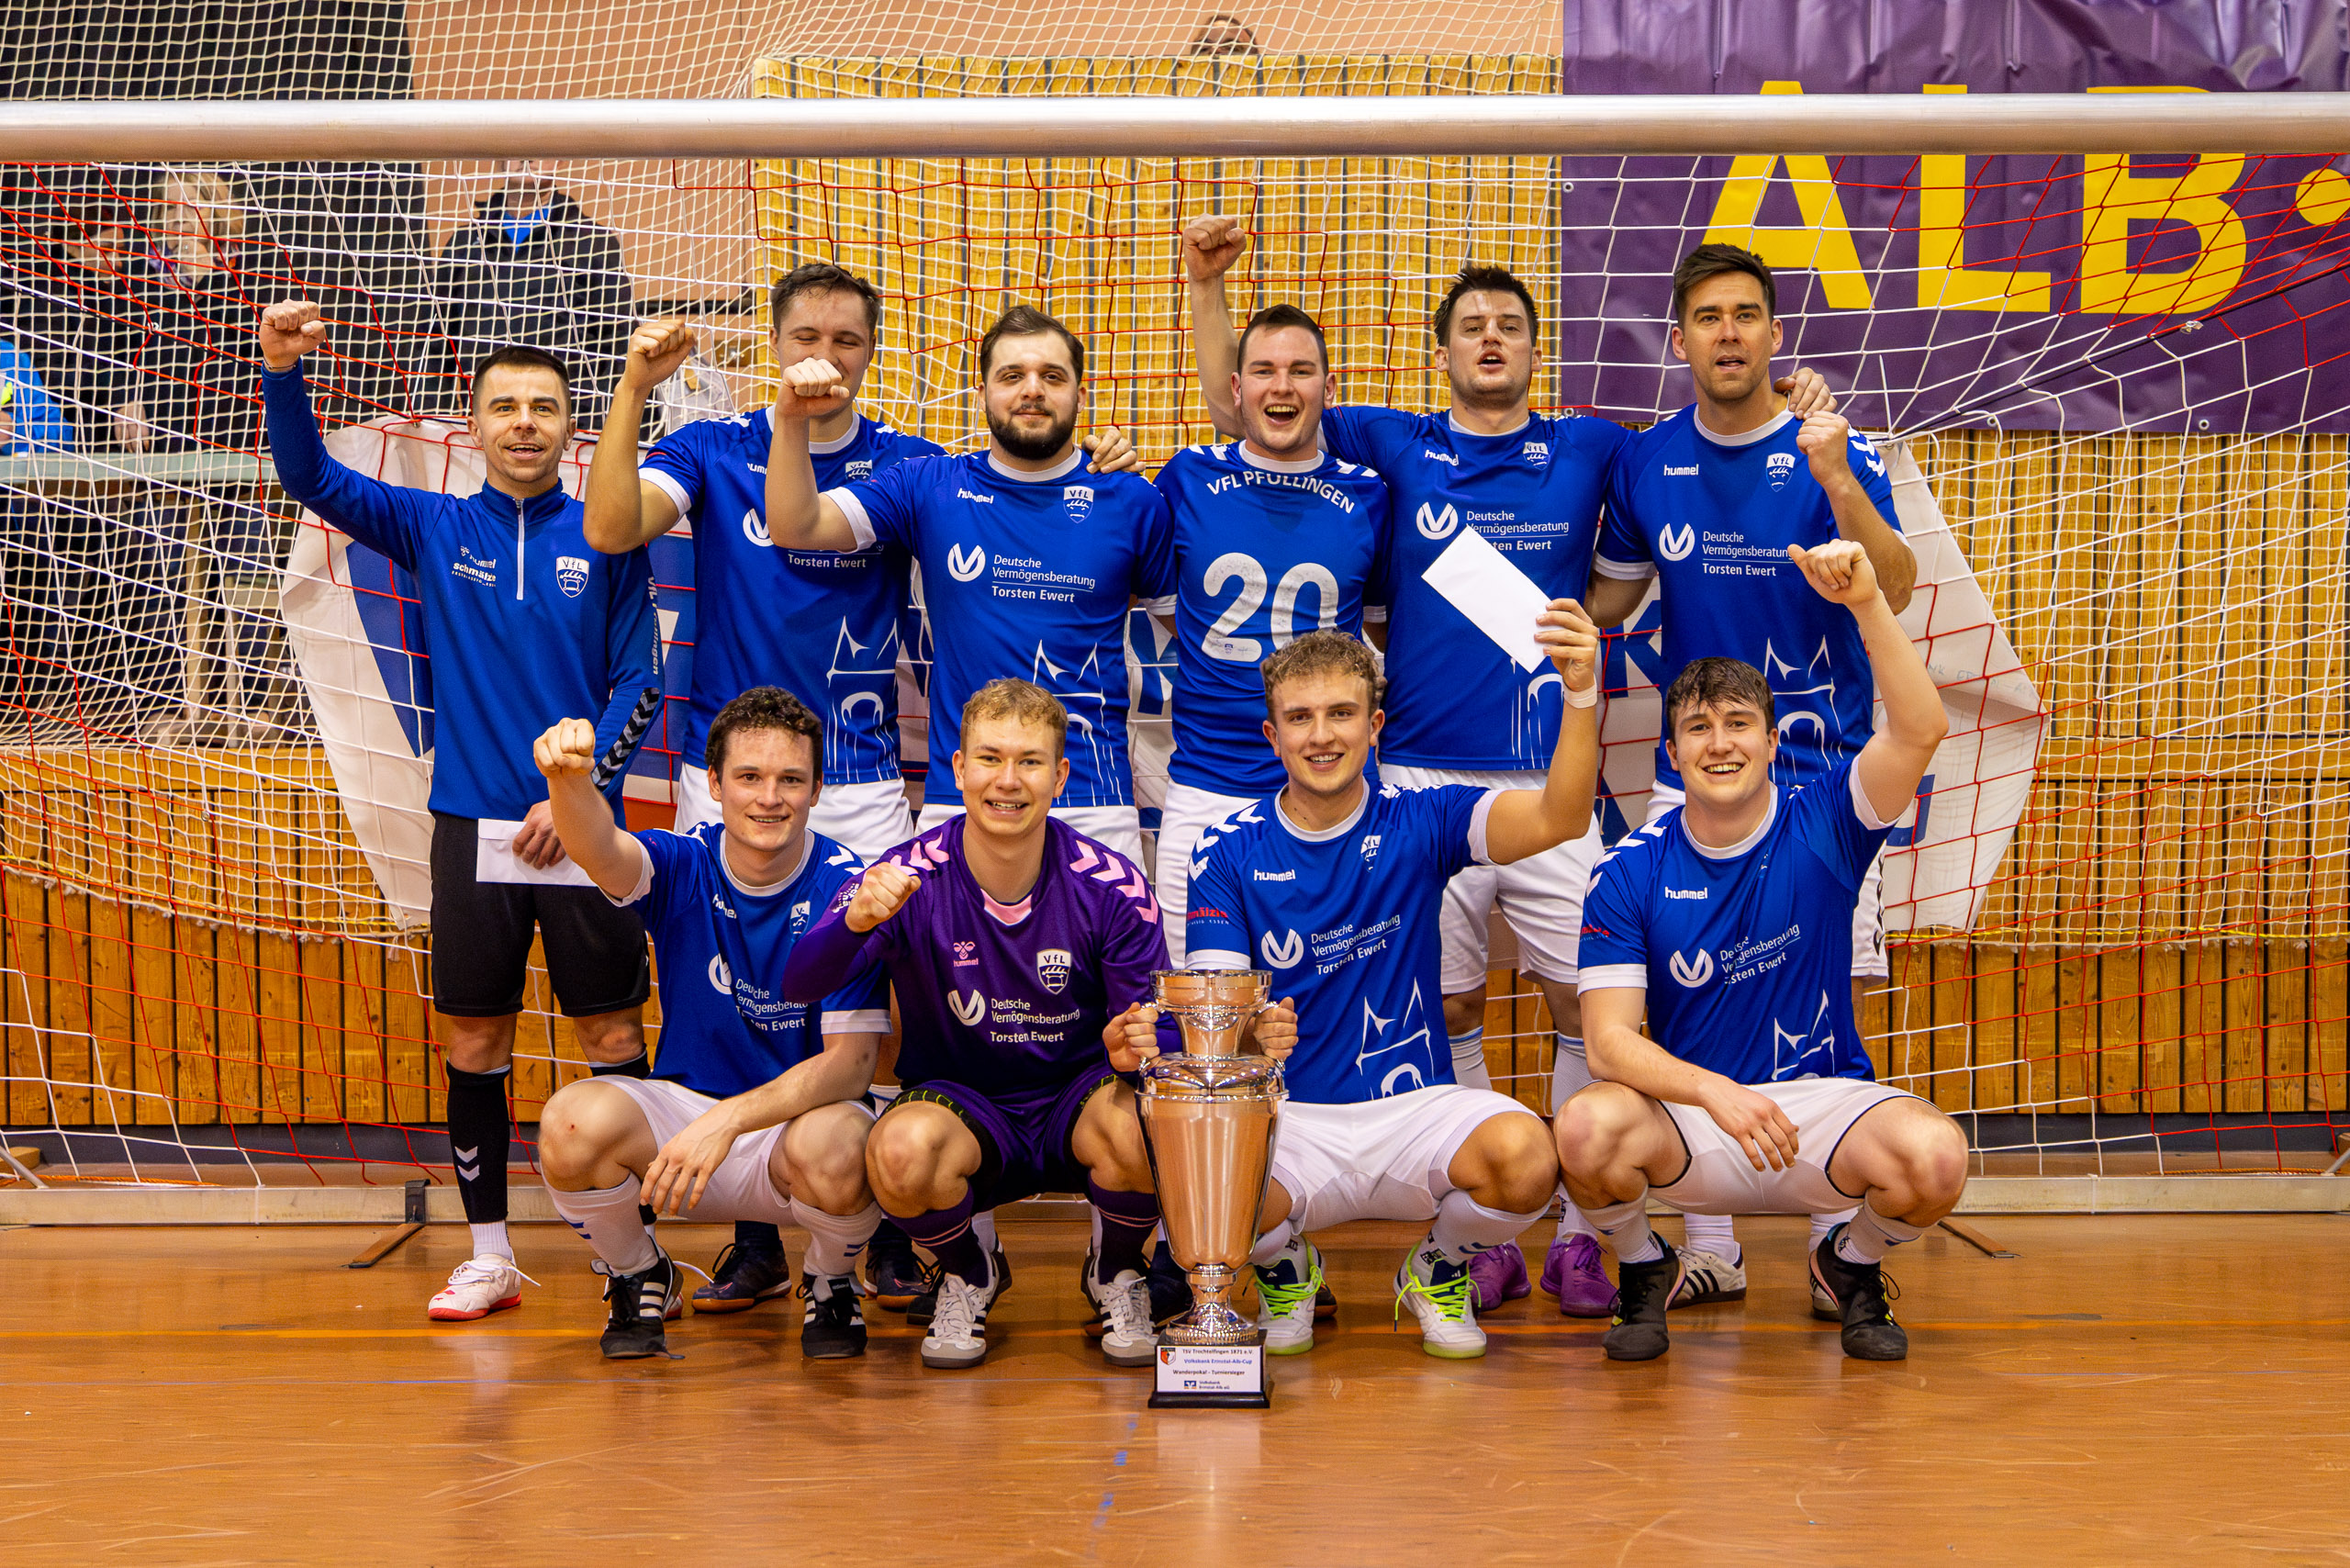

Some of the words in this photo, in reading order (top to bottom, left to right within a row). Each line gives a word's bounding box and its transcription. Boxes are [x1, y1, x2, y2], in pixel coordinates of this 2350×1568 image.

[1701, 80, 2247, 314] ALB
[1773, 457, 1790, 465] VfL
[1663, 464, 1699, 476] hummel
[957, 487, 994, 504] hummel
[1069, 489, 1089, 499] VfL
[1206, 474, 1242, 496] VFL
[1243, 470, 1355, 514] PFULLINGEN
[1467, 510, 1515, 521] Deutsche
[1703, 531, 1744, 543] Deutsche
[1516, 540, 1551, 551] Ewert
[562, 558, 583, 571] VfL
[788, 554, 830, 568] Torsten
[834, 557, 867, 568] Ewert
[994, 554, 1042, 568] Deutsche
[1702, 563, 1742, 576] Torsten
[1745, 565, 1777, 577] Ewert
[992, 566, 1096, 589] Vermögensberatung
[991, 586, 1036, 599] Torsten
[1039, 588, 1075, 602] Ewert
[1202, 552, 1339, 663] 20
[1253, 868, 1296, 882] hummel
[1664, 886, 1708, 900] hummel
[1311, 923, 1353, 945] Deutsche
[1311, 913, 1401, 958] Vermögensberatung
[1357, 938, 1387, 958] Ewert
[953, 958, 979, 967] hummel
[1044, 954, 1066, 964] VfL
[772, 1017, 806, 1032] Ewert
[990, 1031, 1030, 1043] Torsten
[1031, 1031, 1065, 1042] Ewert
